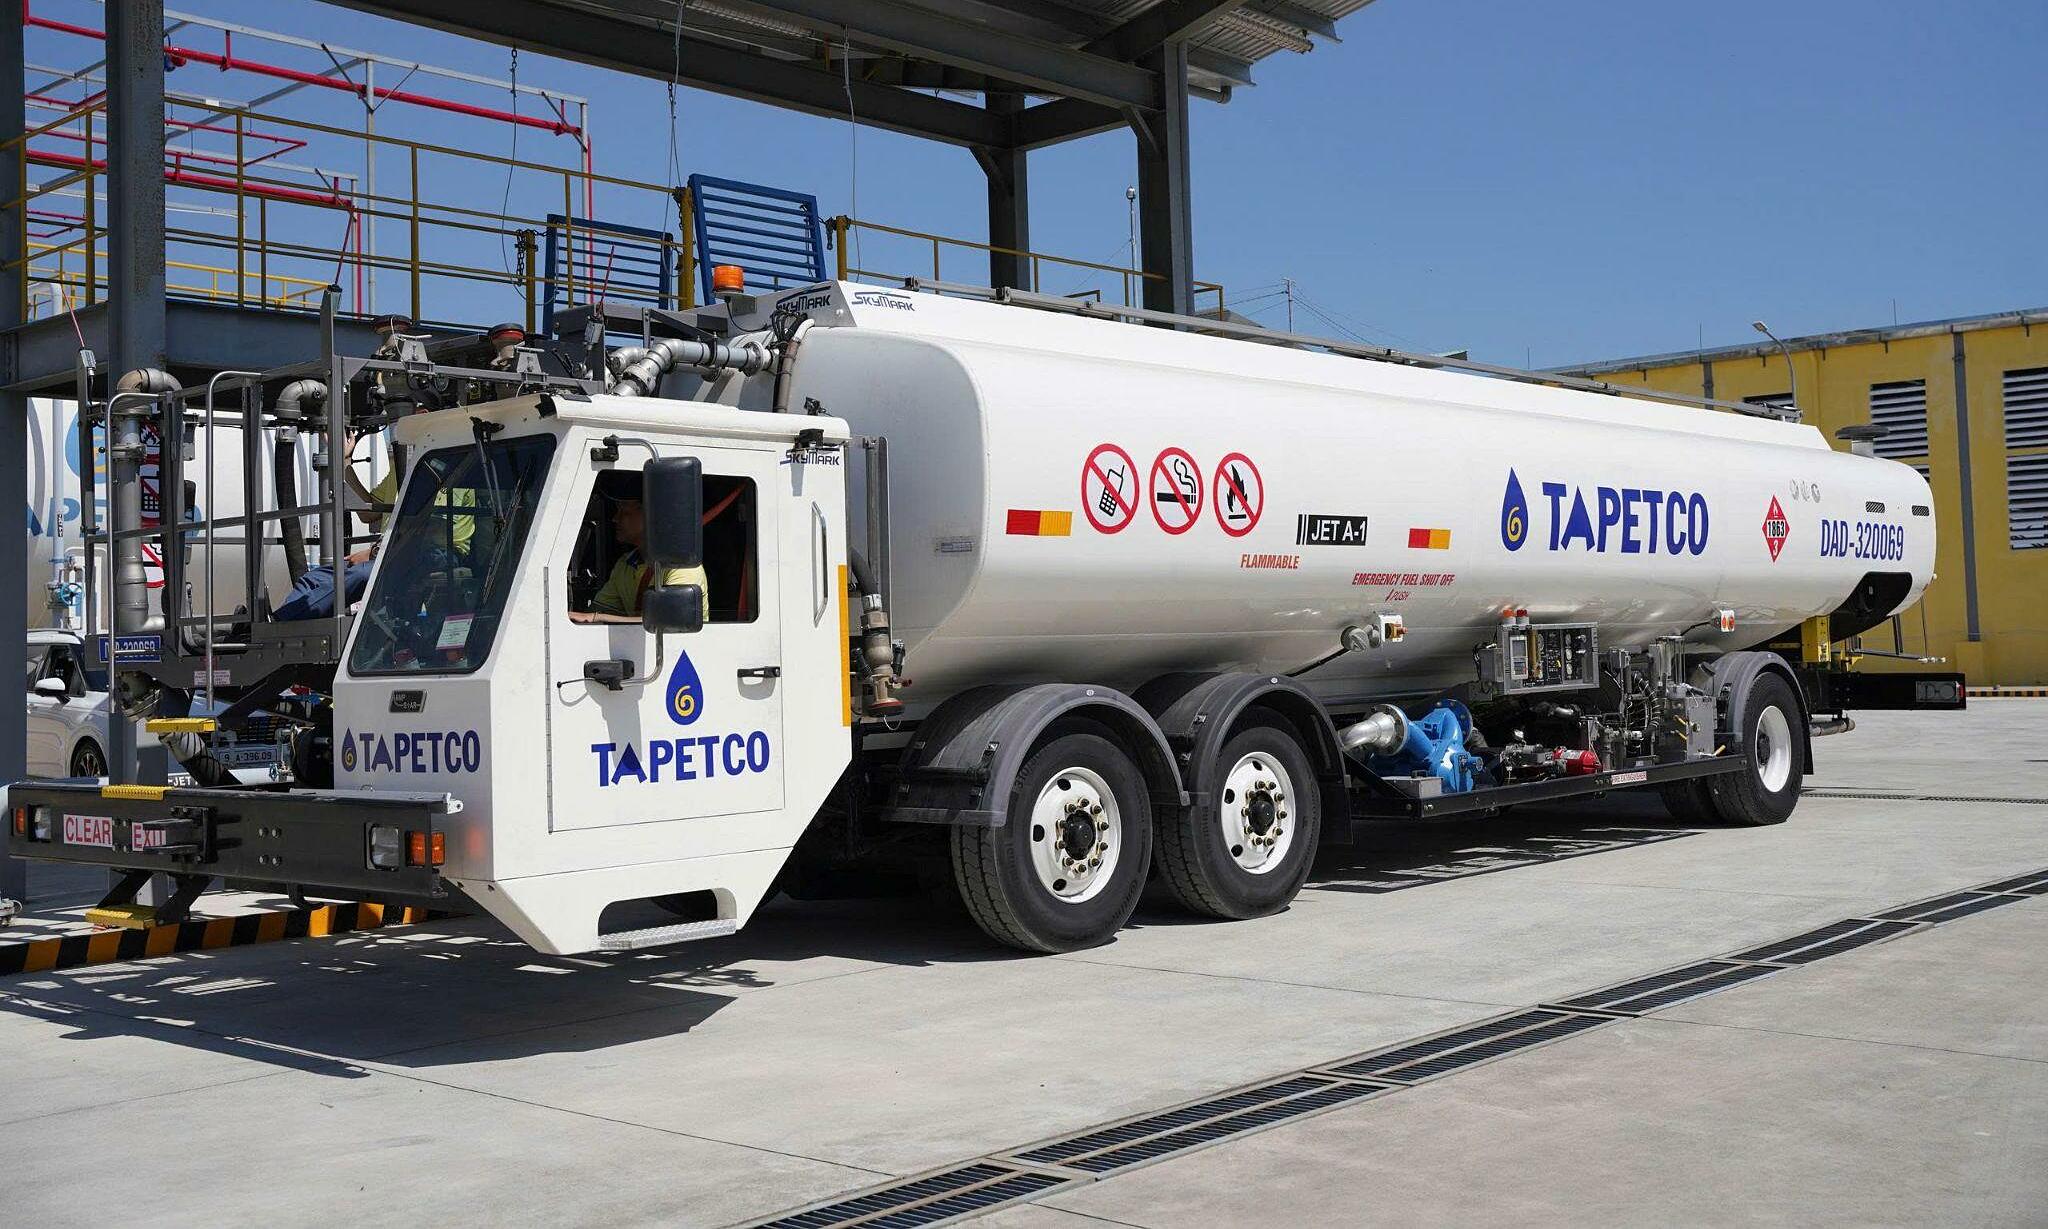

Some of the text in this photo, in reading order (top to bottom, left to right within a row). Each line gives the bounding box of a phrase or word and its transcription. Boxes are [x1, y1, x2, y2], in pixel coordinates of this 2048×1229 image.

[1311, 520, 1367, 543] JET A-1
[1541, 481, 1710, 556] TAPETCO
[1767, 520, 1785, 538] 1863
[1772, 539, 1780, 557] 3
[1819, 519, 1905, 562] DAD-320069
[1240, 553, 1300, 570] FLAMMABLE
[1352, 572, 1456, 586] EMERGENCY FUEL SHUT OFF
[359, 729, 481, 774] TAPETCO
[590, 730, 771, 788] TAPETCO
[65, 816, 113, 846] CLEAR
